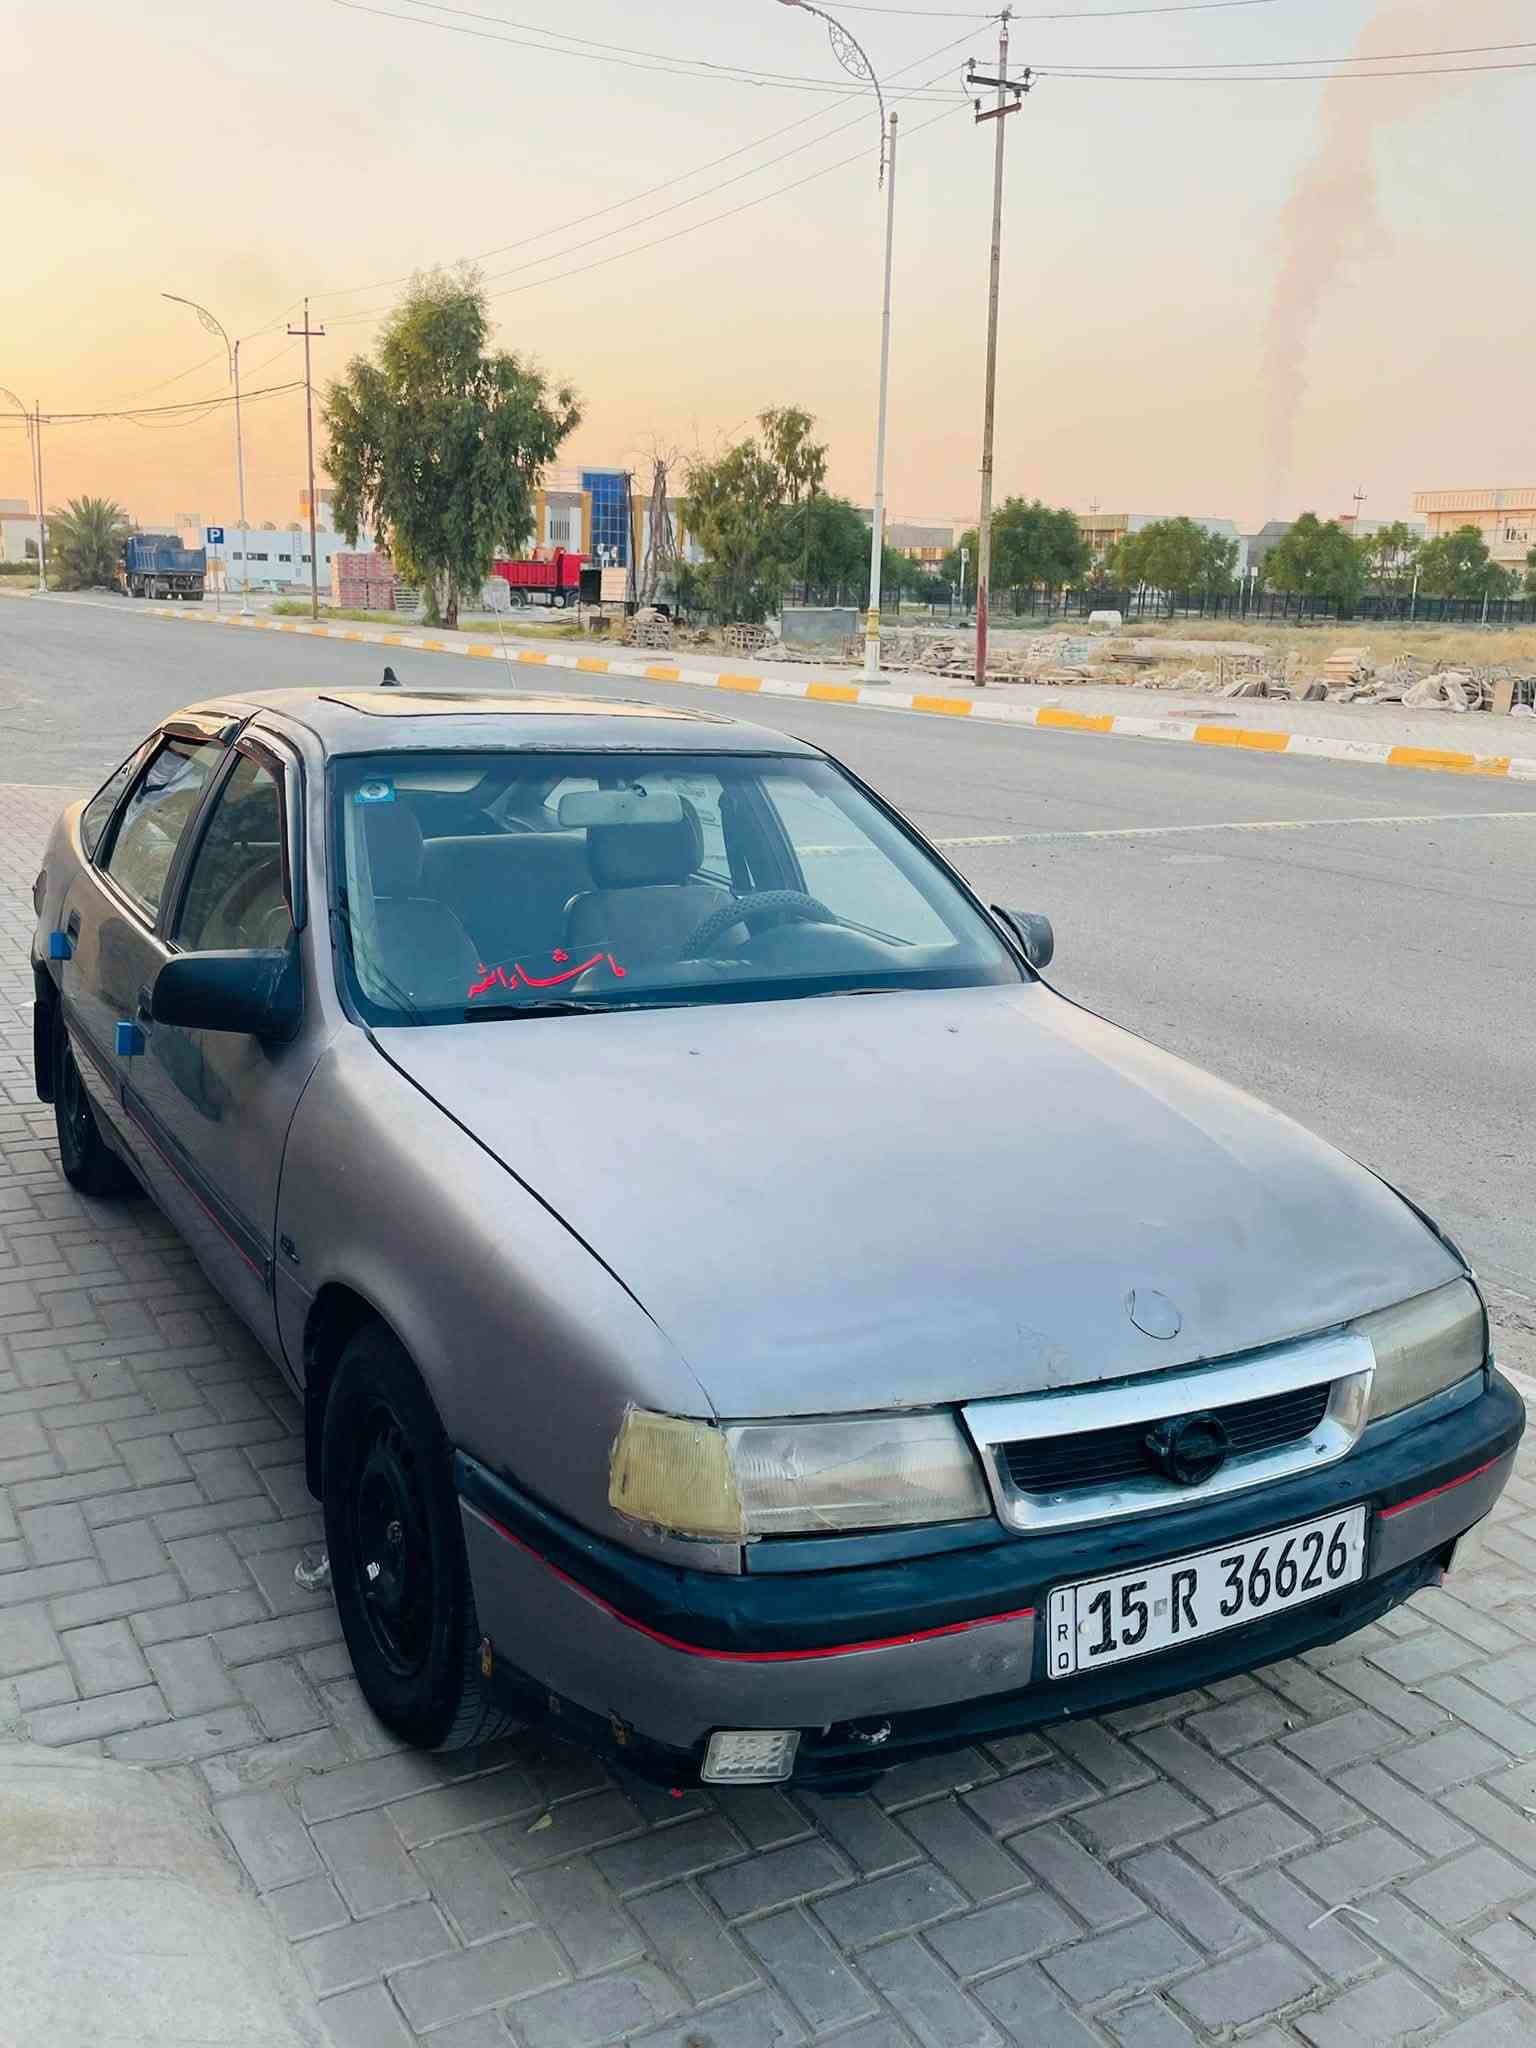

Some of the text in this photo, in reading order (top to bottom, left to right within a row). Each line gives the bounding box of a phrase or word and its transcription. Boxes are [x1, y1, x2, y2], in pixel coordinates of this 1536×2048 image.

[210, 529, 221, 542] P
[1088, 1520, 1346, 1656] 15 R 36626
[1057, 1594, 1071, 1670] IRQ
